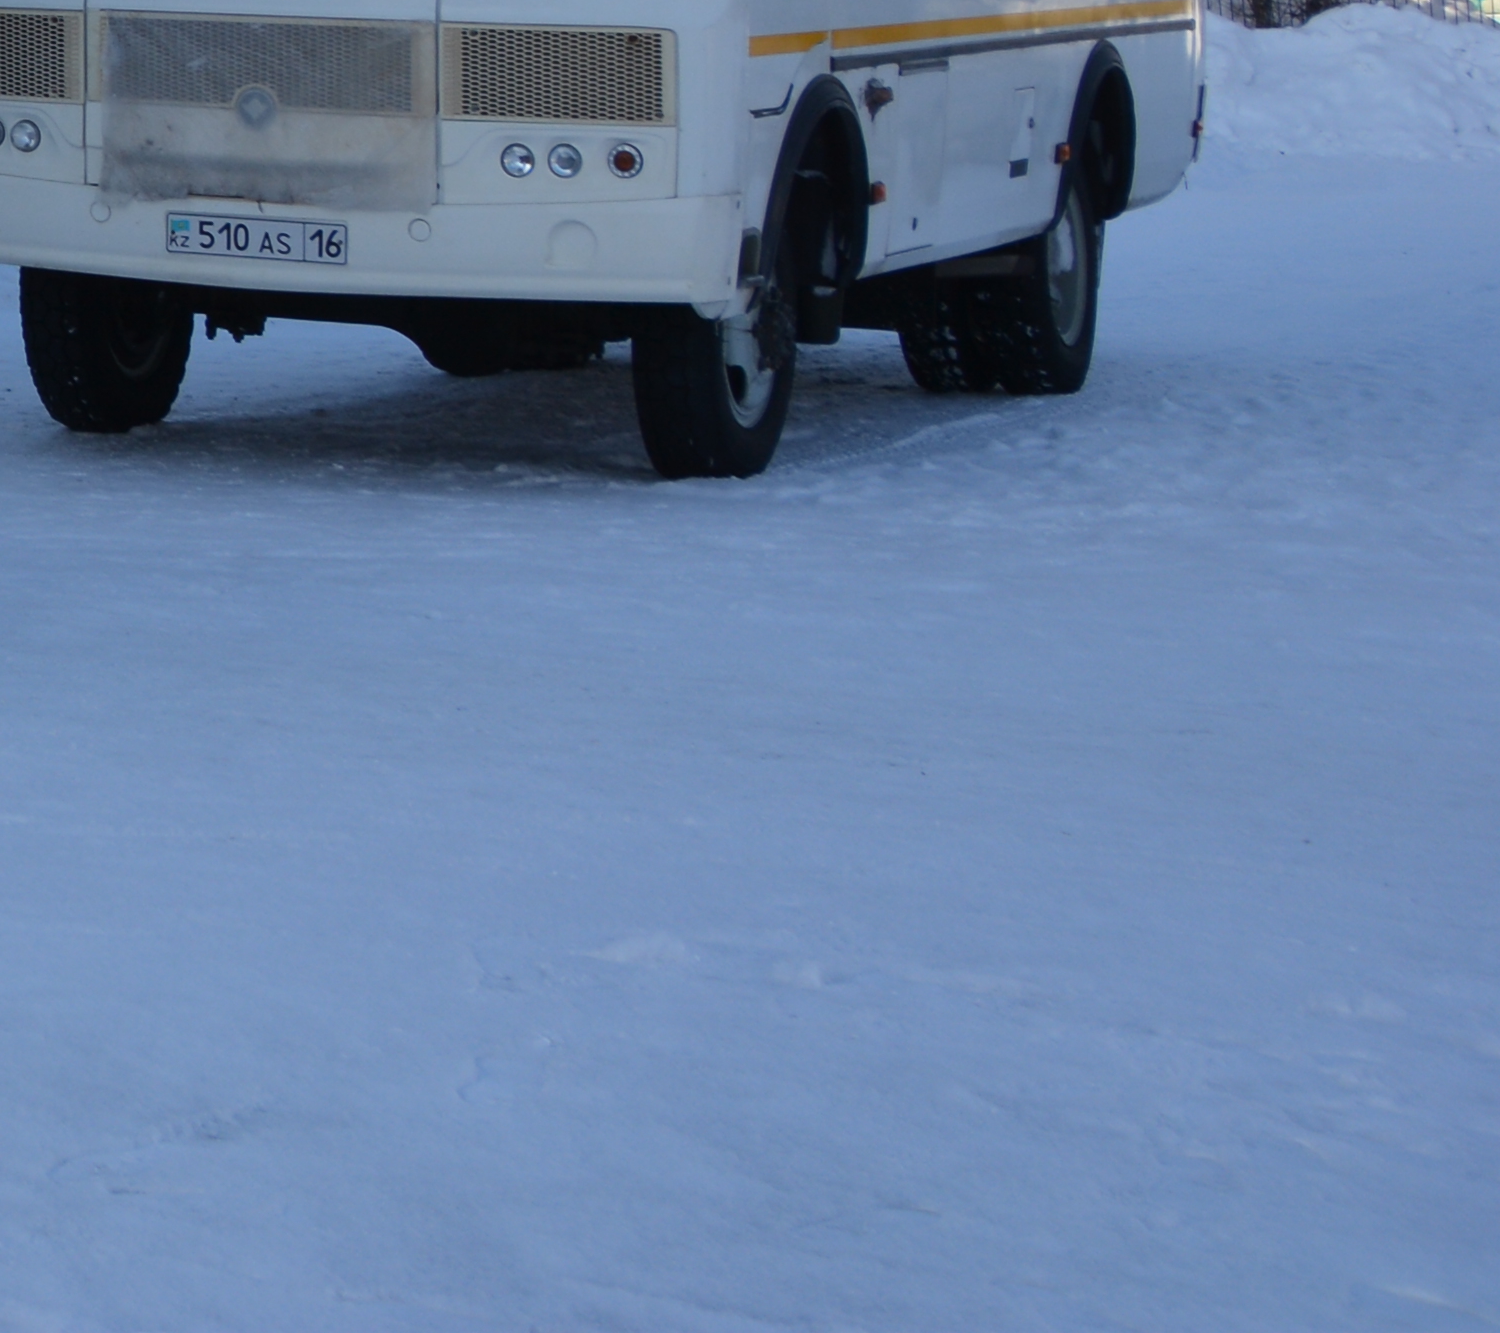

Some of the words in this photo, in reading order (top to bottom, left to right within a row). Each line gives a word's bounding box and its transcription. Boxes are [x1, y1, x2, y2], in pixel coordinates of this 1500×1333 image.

[169, 234, 190, 248] KZ
[199, 220, 249, 251] 510
[259, 231, 291, 255] AS
[309, 229, 342, 258] 16
